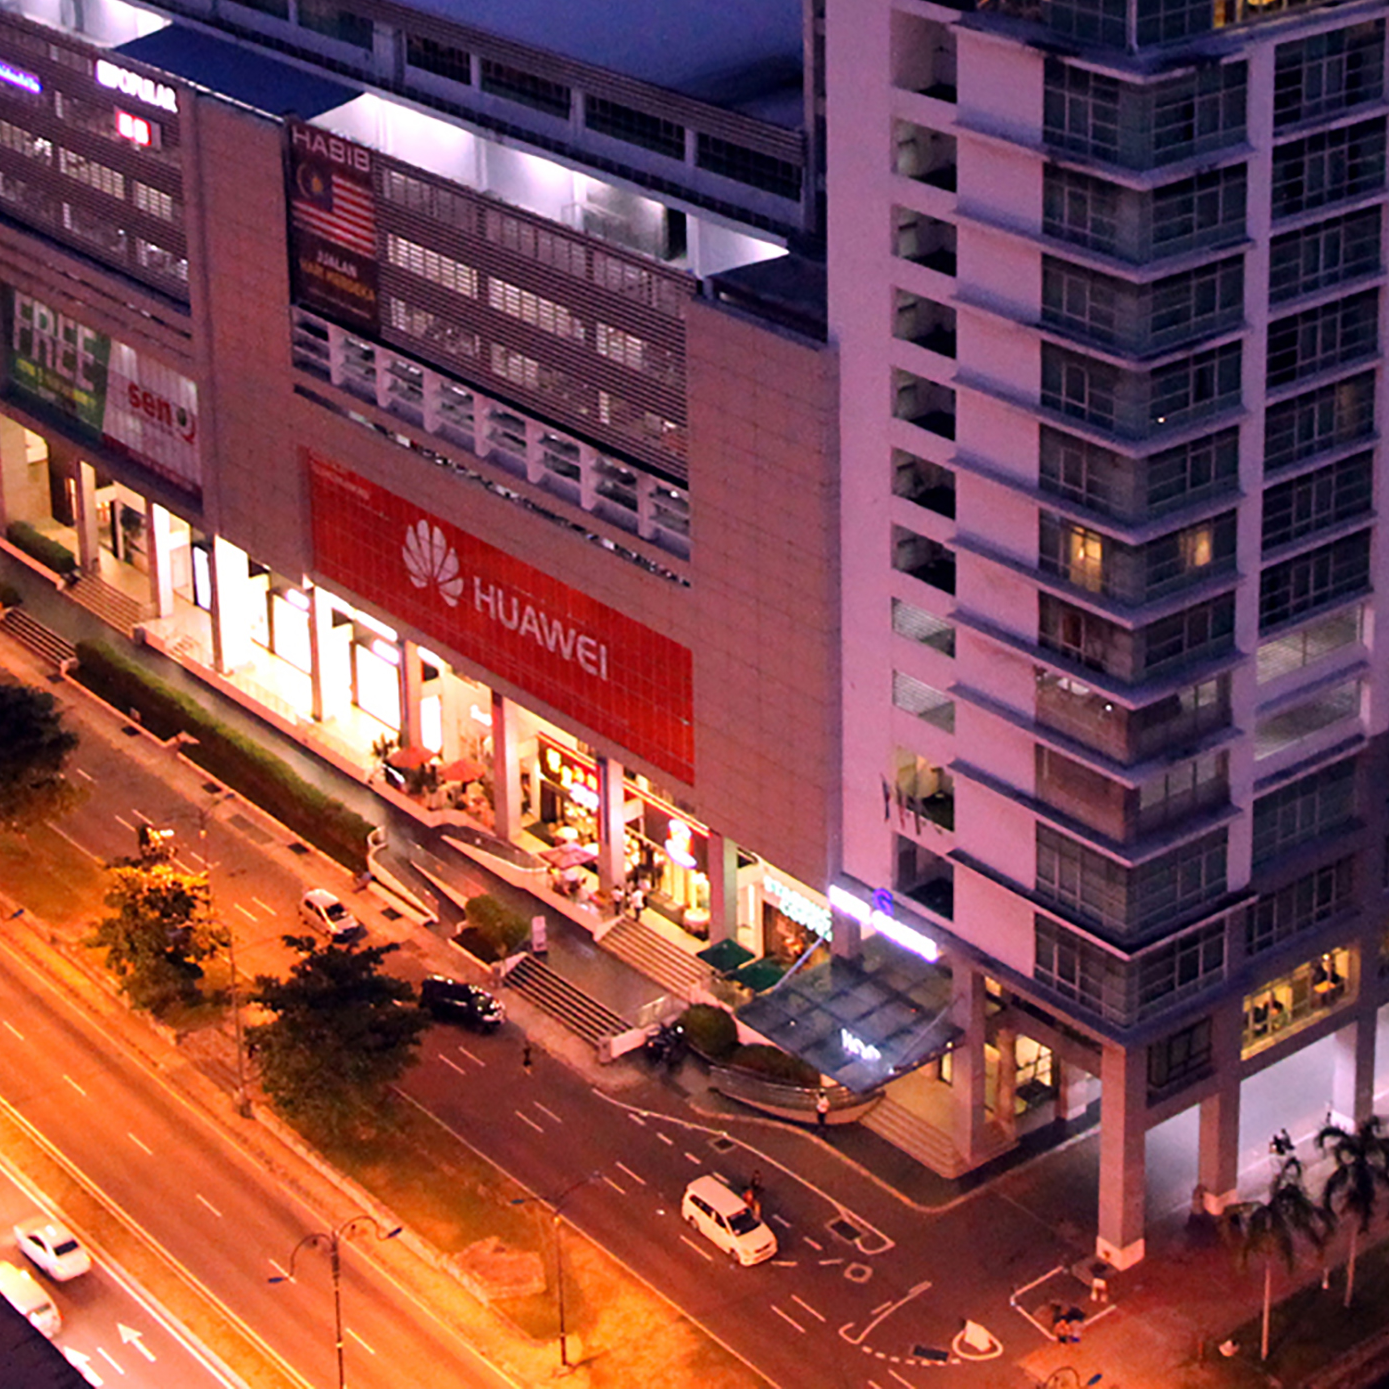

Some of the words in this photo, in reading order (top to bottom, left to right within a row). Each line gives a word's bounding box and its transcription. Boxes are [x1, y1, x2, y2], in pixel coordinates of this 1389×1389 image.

[292, 125, 371, 172] HABIB
[13, 289, 96, 391] FREE
[473, 575, 608, 681] HUAWEI
